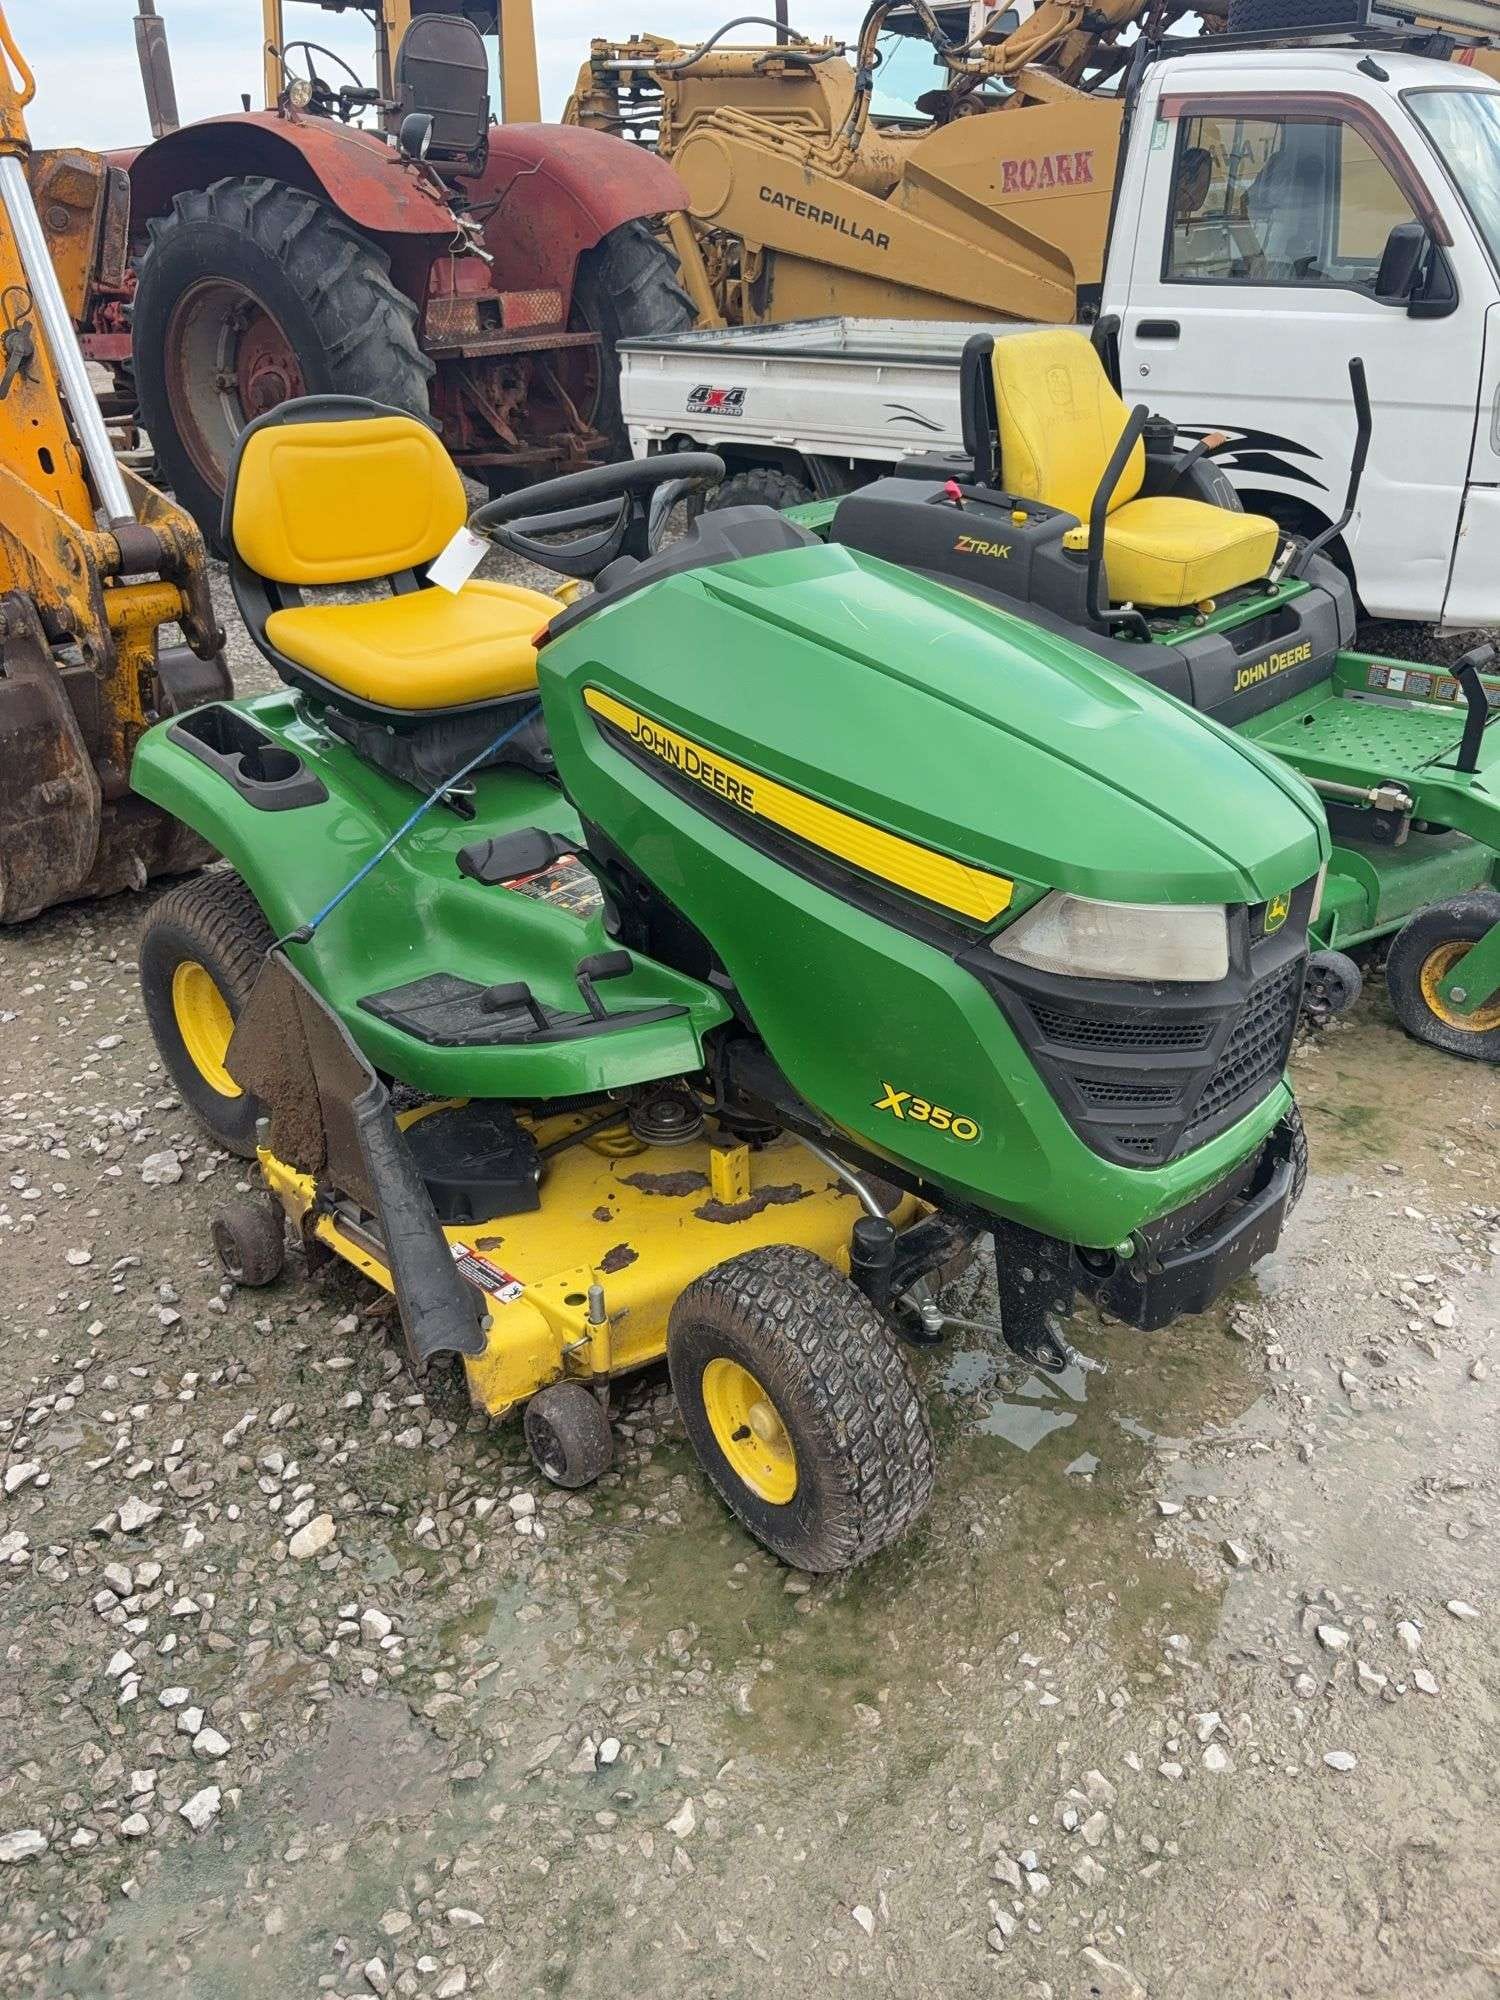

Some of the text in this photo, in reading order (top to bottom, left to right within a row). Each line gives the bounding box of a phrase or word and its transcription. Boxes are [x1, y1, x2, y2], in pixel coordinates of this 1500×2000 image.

[1002, 150, 1094, 193] ROARK
[759, 186, 890, 250] CATERPILLAR
[687, 404, 708, 413] OFF
[953, 535, 1012, 559] ZTRAK
[1233, 641, 1312, 692] JOHN DEERE
[630, 716, 754, 809] JOHN DEERE
[870, 1080, 980, 1141] X350
